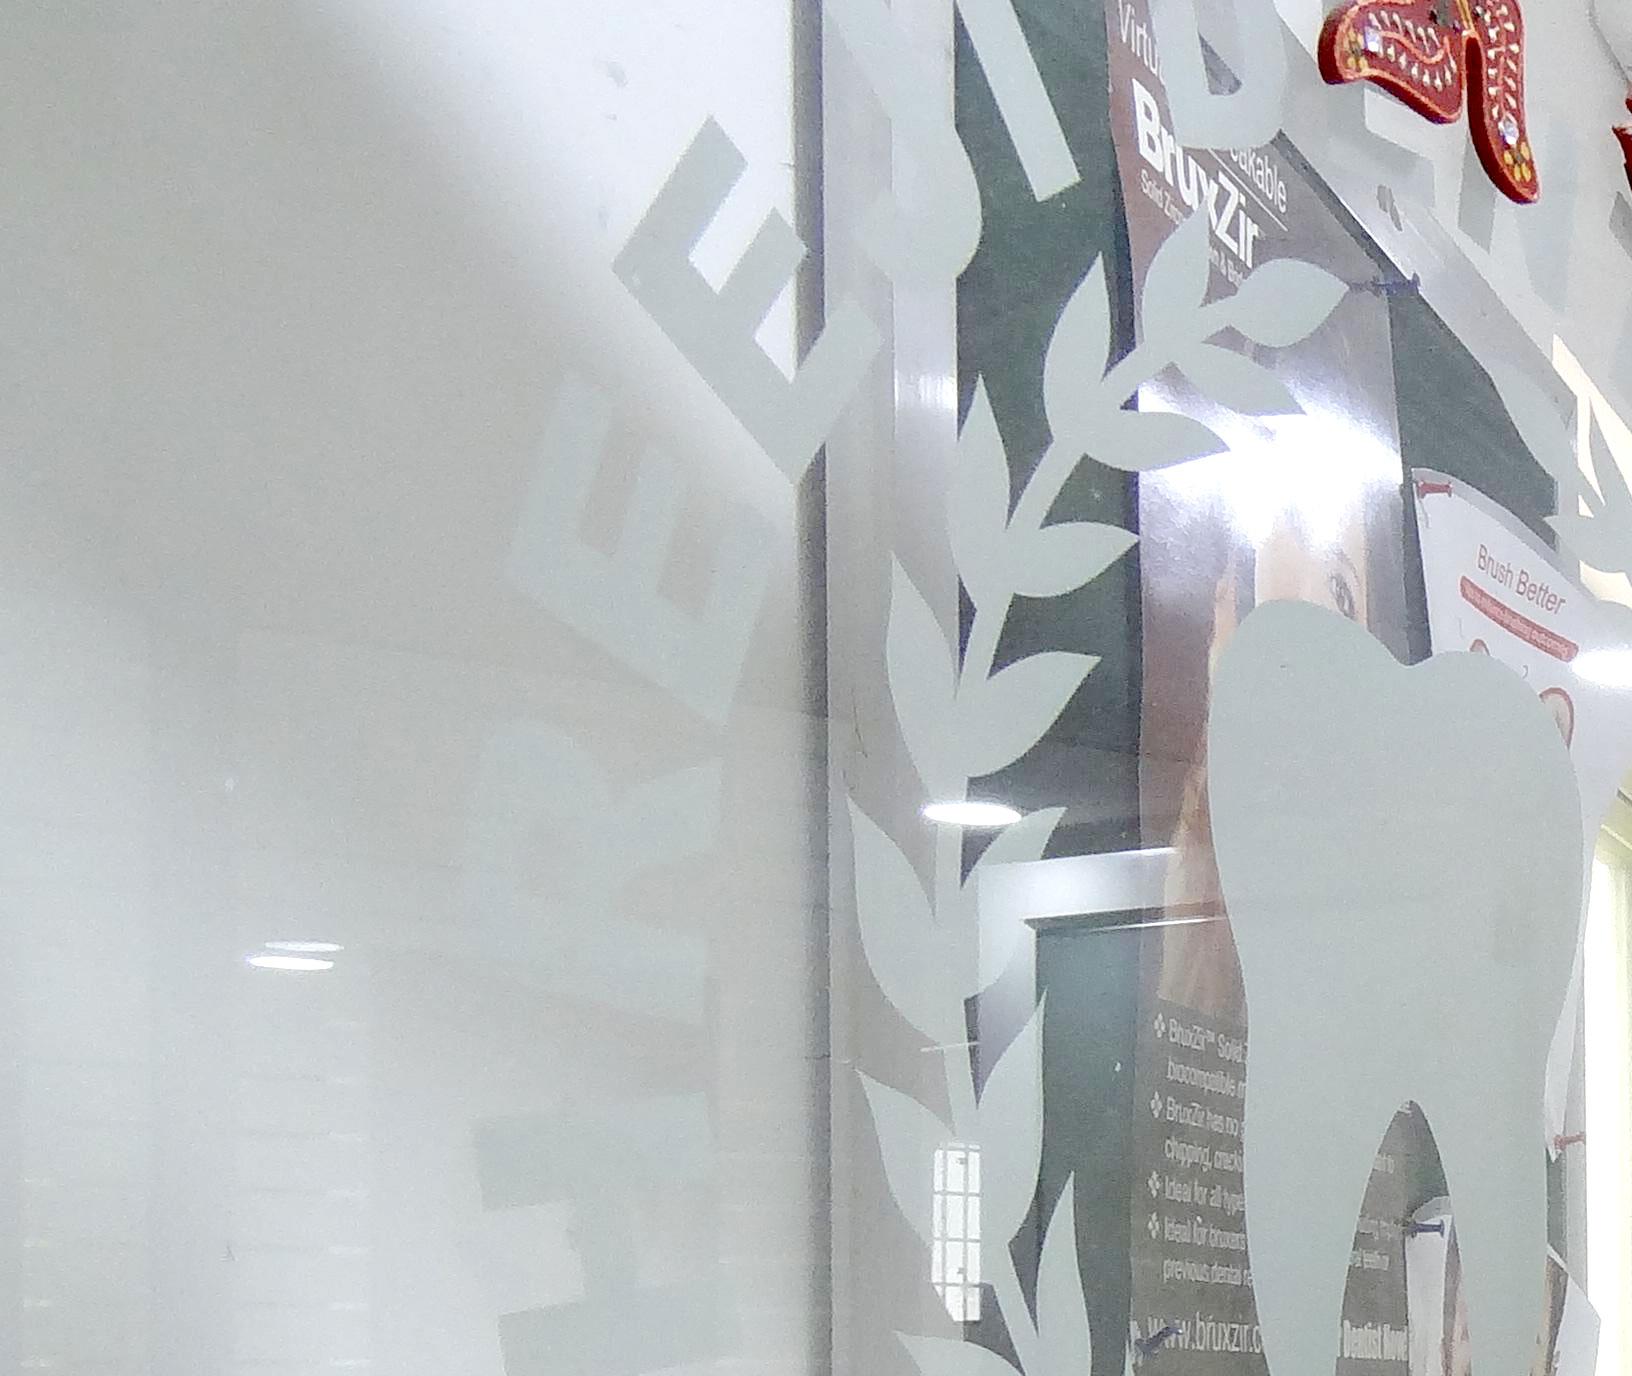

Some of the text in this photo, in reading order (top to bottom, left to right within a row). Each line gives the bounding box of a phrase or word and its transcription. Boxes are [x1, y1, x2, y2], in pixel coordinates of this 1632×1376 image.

[1132, 78, 1259, 269] BruxZir
[1477, 543, 1567, 614] Brush Better
